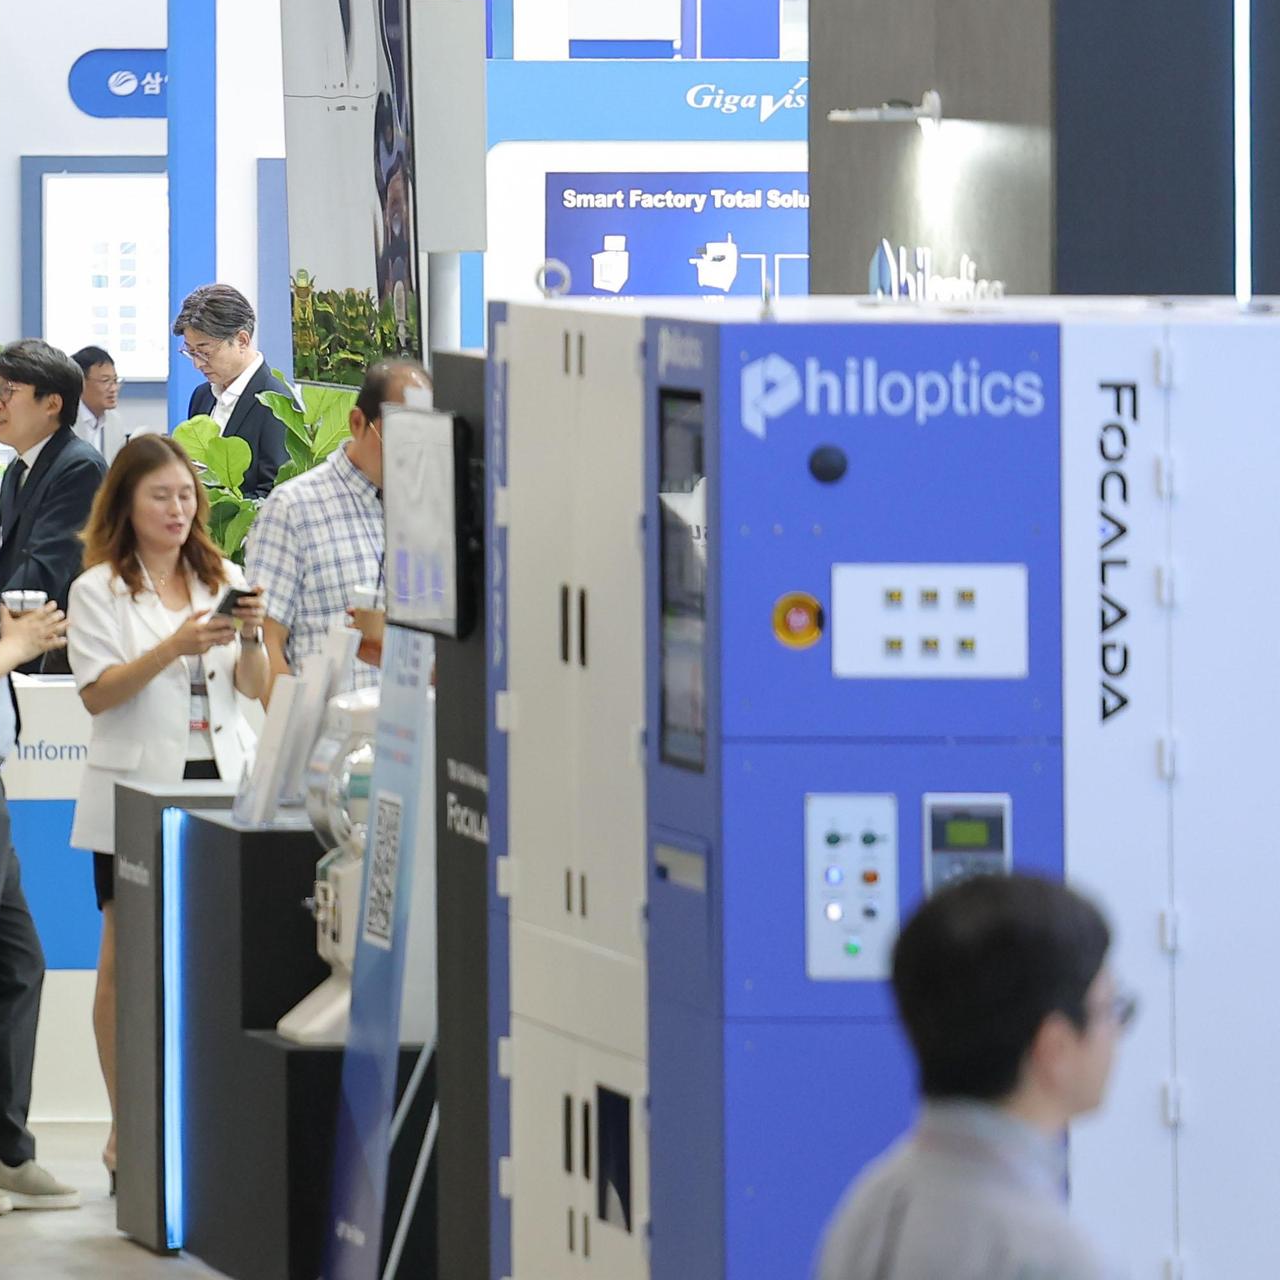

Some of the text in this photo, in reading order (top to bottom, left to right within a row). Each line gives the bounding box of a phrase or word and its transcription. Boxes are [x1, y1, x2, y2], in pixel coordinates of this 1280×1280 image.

[563, 189, 809, 212] Smart Factory Total Solu
[741, 353, 1045, 439] Philoptics
[1099, 383, 1137, 724] FOCALADA
[17, 739, 88, 761] Inform
